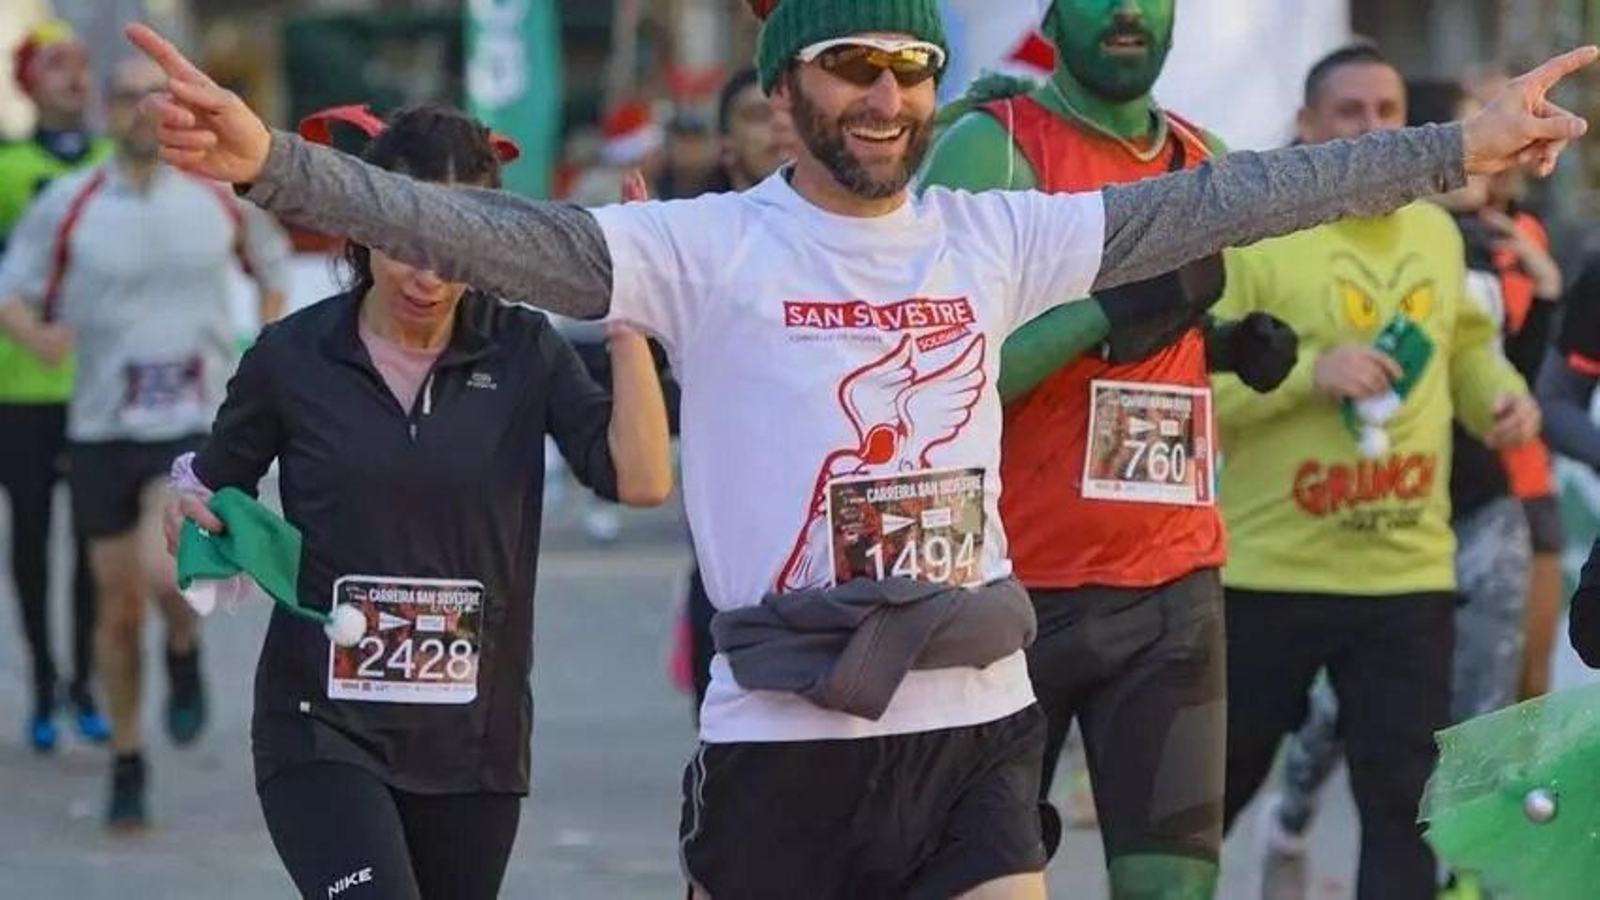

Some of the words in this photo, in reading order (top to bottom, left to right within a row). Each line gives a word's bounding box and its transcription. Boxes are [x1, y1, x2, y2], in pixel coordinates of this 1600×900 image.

[788, 304, 844, 327] SAN
[1123, 440, 1187, 483] 760
[864, 532, 976, 582] 1494
[357, 636, 473, 680] 2428
[328, 866, 373, 900] NIKE
